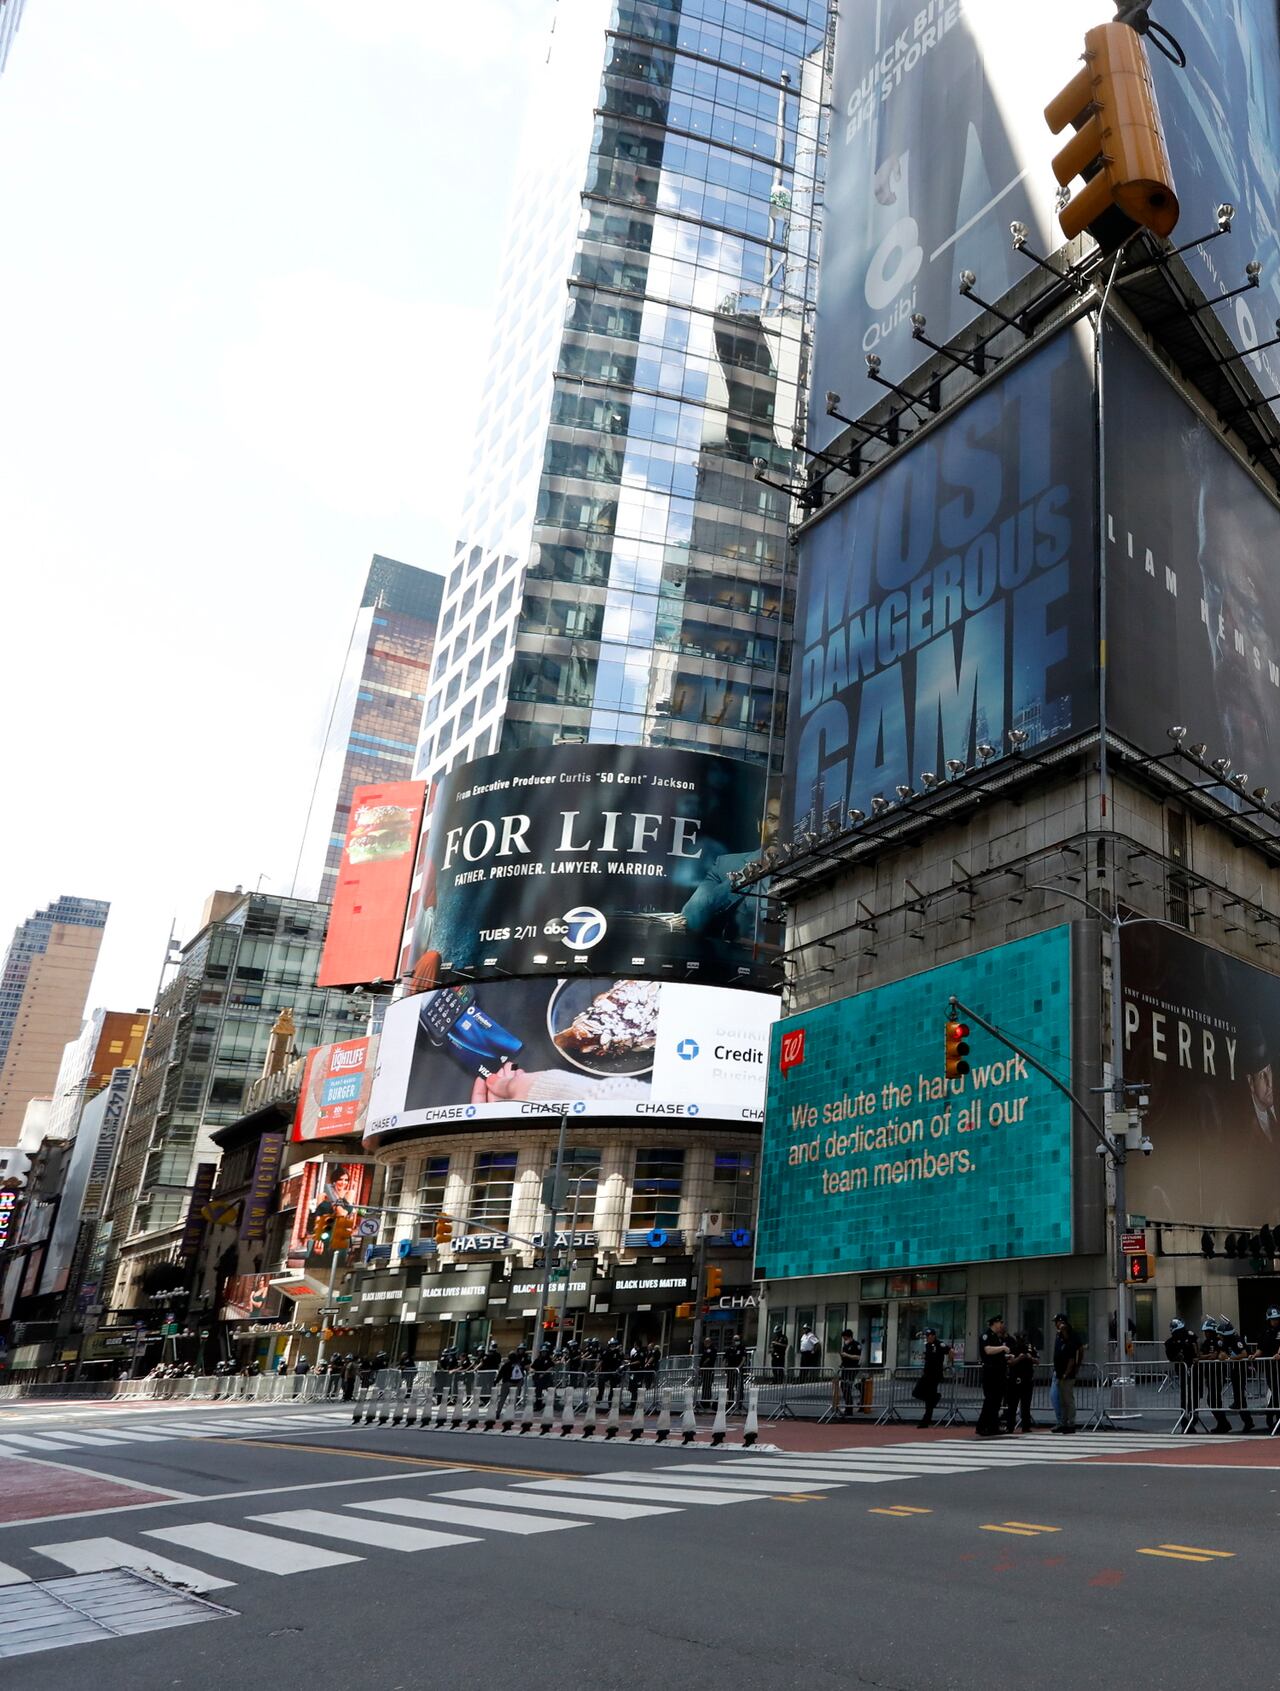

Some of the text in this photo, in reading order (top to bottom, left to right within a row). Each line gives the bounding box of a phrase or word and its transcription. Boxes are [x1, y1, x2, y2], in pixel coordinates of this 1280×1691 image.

[881, 0, 961, 101] STORIE
[848, 26, 909, 116] QUICK
[862, 284, 918, 352] Quibi
[805, 350, 1066, 648] MOST
[1107, 514, 1178, 598] LIAM
[802, 483, 1071, 717] DANGEROUS
[790, 558, 1072, 832] GAME
[456, 790, 470, 802] From
[472, 780, 510, 795] Executive
[512, 774, 556, 787] Producer
[559, 772, 591, 783] Curtis
[651, 776, 695, 790] Jackson
[441, 811, 703, 871] FOR LIFE
[454, 861, 667, 887] FATHER. PRISONER. LAWYER. WARRIOR.
[479, 926, 537, 942] TUES 2/11
[543, 921, 569, 935] abc
[1182, 1006, 1211, 1025] MATTHEW
[1125, 1001, 1236, 1081] PERRY
[714, 1045, 763, 1064] Credit
[112, 1069, 131, 1092] NEW
[328, 1085, 355, 1102] BURGER
[792, 1103, 818, 1131] We
[823, 1090, 876, 1124] salute
[881, 1082, 912, 1110] the
[972, 1053, 1028, 1090] work
[425, 1108, 463, 1120] CHASE
[520, 1103, 570, 1114] CHASE
[635, 1103, 684, 1115] CHASE
[372, 1117, 390, 1131] CHASE
[789, 1096, 1028, 1165] and dedication of all our
[823, 1149, 976, 1194] team members.
[247, 1137, 279, 1237] NEW VICTORY
[362, 1292, 375, 1301] BLACK
[375, 1291, 386, 1300] LIVES
[387, 1290, 402, 1299] MATTER
[422, 1286, 486, 1298] BLACK LIVES MATTER
[513, 1281, 586, 1294] BLACK LIES MTTER
[615, 1278, 687, 1290] BLACK LIVES MATTER
